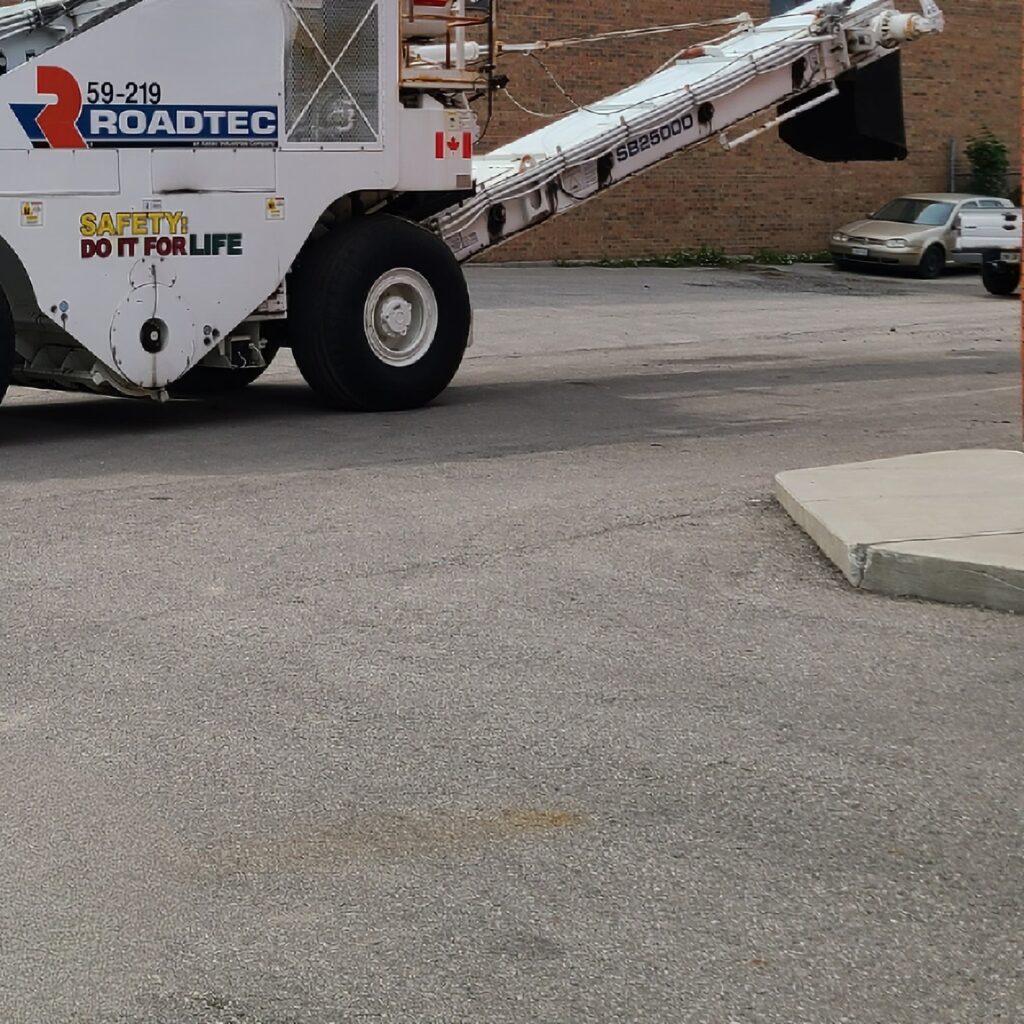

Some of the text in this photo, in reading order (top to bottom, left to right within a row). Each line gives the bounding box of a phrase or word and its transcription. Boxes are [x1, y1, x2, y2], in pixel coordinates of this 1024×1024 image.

[87, 81, 162, 104] 59-219
[89, 109, 276, 135] ROADTEC
[80, 211, 189, 237] SAFETY:
[81, 233, 243, 258] DO IT FOR LIFE
